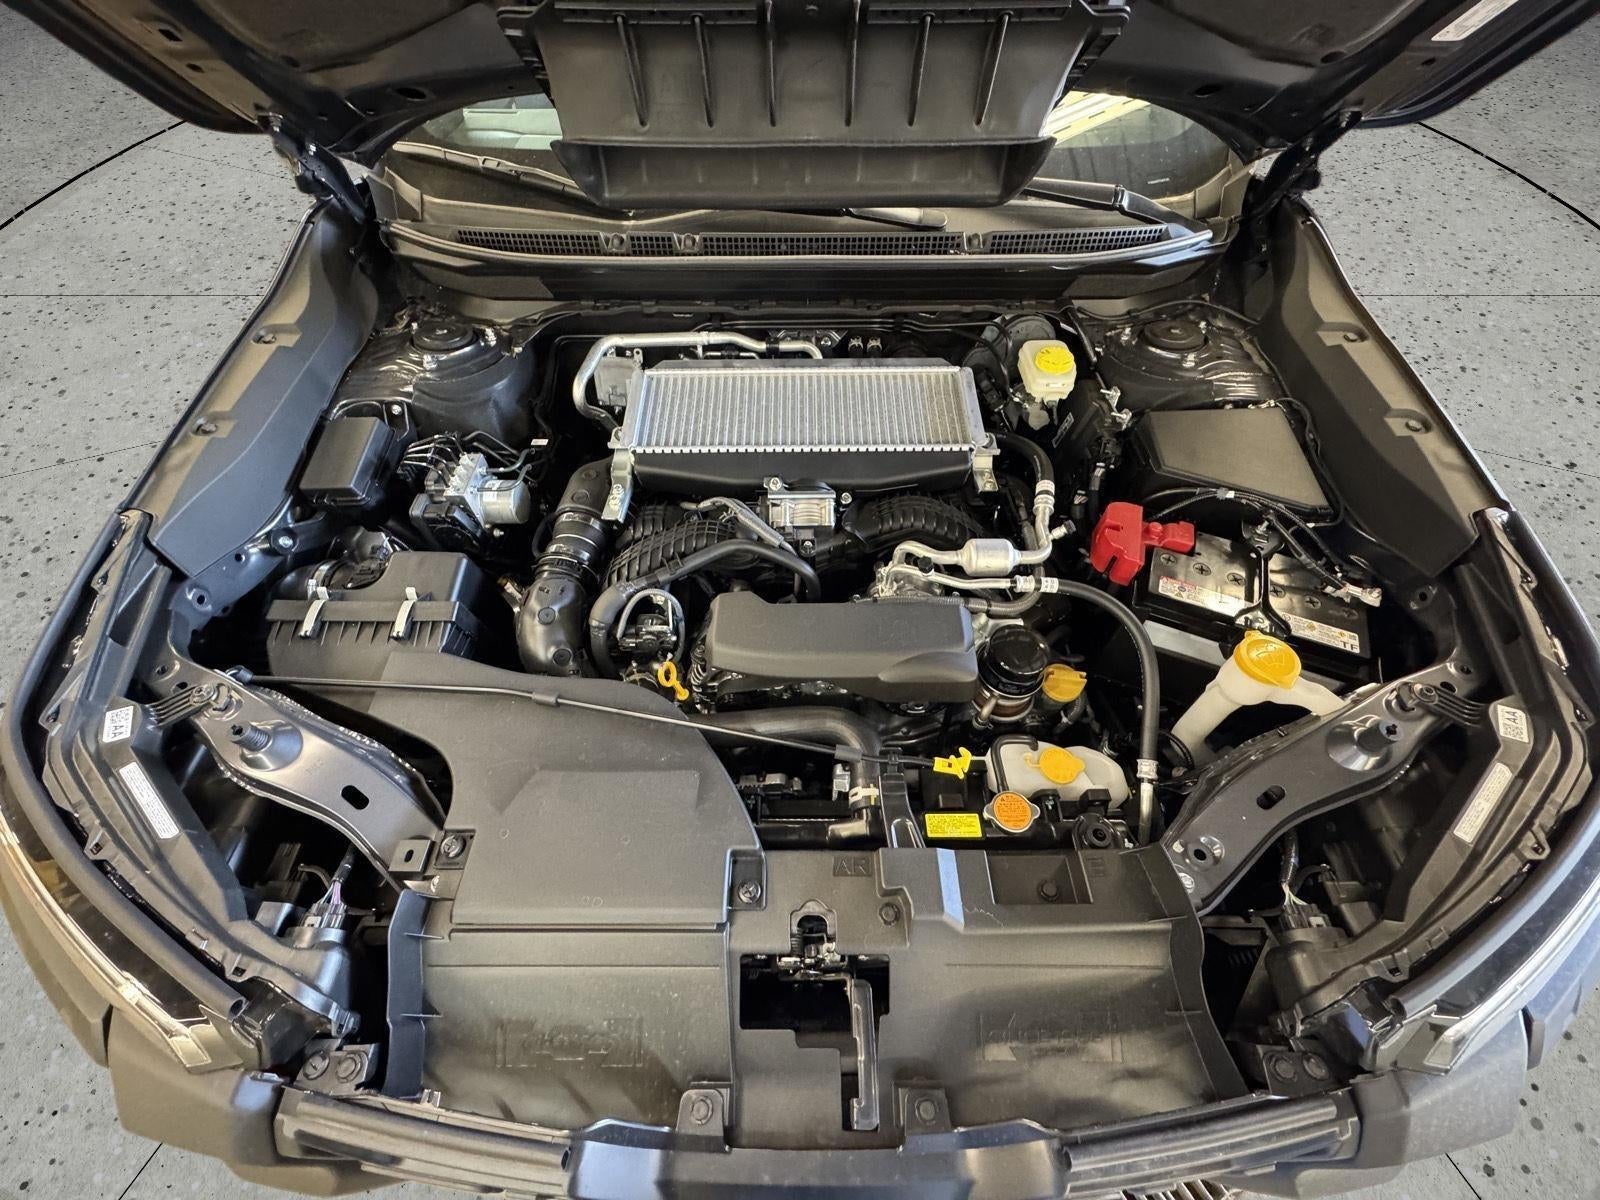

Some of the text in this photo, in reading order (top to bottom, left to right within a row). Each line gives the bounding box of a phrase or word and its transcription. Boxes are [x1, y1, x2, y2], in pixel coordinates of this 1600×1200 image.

[1340, 640, 1358, 651] TF
[1504, 711, 1518, 724] AA
[112, 725, 124, 738] AA
